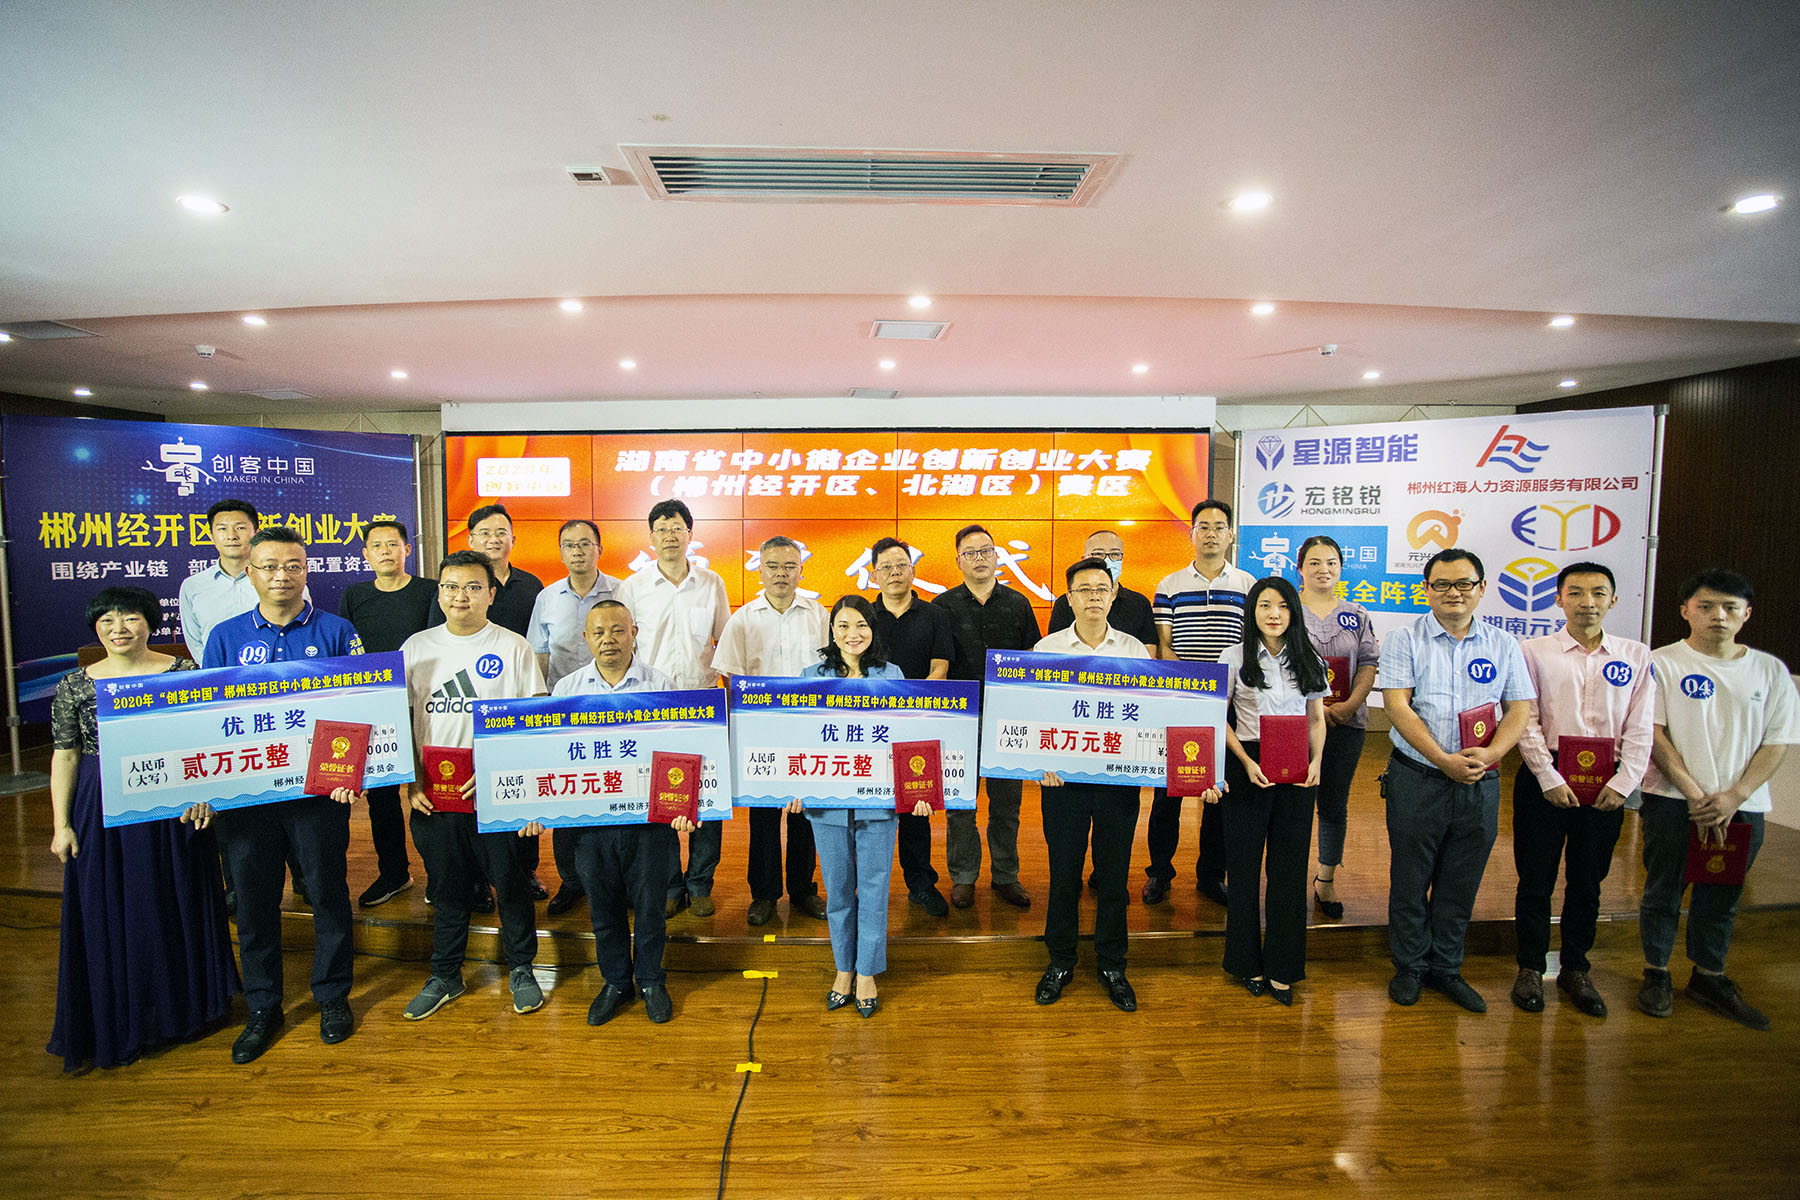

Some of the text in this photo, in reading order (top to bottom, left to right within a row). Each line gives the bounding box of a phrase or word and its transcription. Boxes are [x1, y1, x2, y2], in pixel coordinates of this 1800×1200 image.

[1293, 433, 1418, 466] 星源智能
[212, 454, 314, 475] 创客中国
[615, 449, 1152, 472] 湖南省中小微企业创新创业大赛
[223, 475, 305, 484] MAKER IN CHINA
[1407, 476, 1639, 494] 郴州红海人力资源服务有限公司
[1305, 485, 1381, 506] 宏铭锐
[1301, 507, 1381, 516] HONGMINGRUI
[51, 559, 169, 580] 围绕产业链
[1299, 579, 1430, 606] 赛全阵容
[1339, 614, 1358, 628] 08
[242, 646, 266, 663] 09
[478, 658, 500, 676] 02
[1471, 663, 1493, 678] 07
[1606, 664, 1630, 682] 03
[1684, 678, 1712, 696] 04
[1072, 699, 1139, 722] 优胜奖
[221, 709, 306, 737] 优胜奖
[1002, 724, 1028, 737] 人民币
[820, 723, 889, 743] 优胜奖
[1039, 727, 1122, 754] 贰万元整
[567, 739, 638, 761] 优胜奖
[749, 752, 776, 764] 人民币
[129, 758, 165, 774] 人民币
[181, 742, 290, 780] 贰万元整
[787, 752, 873, 777] 贰万元整
[1106, 763, 1166, 776] 郴州经济开发区
[1176, 766, 1207, 776] 荣誉证书
[274, 774, 305, 788] 郴州经
[496, 775, 524, 787] 人民币
[536, 769, 624, 797] 贰万元整
